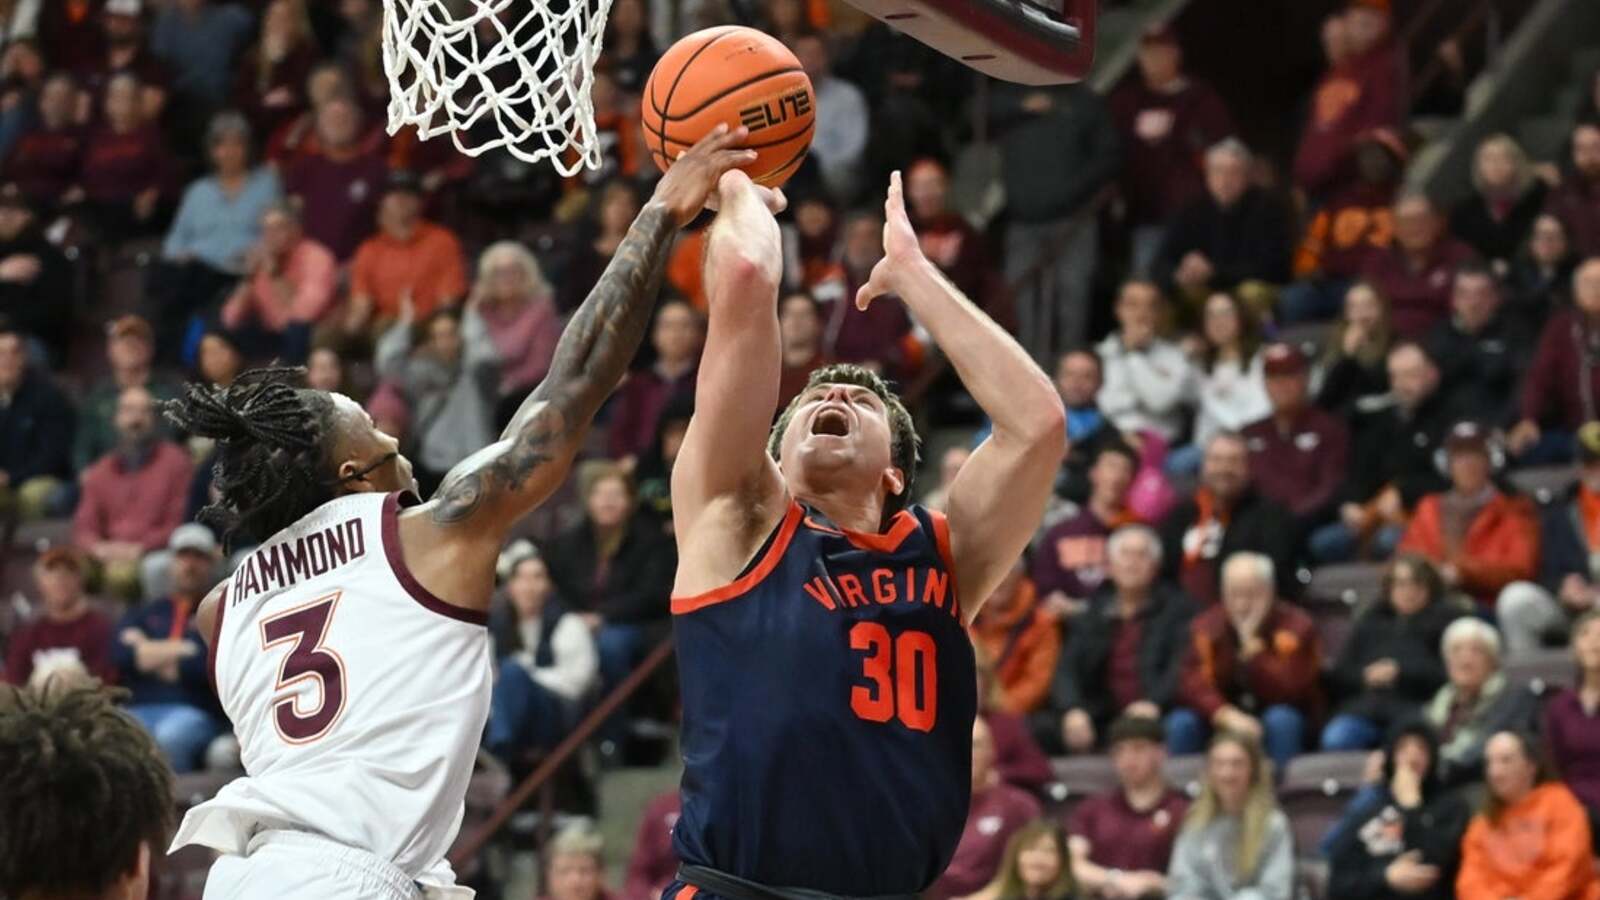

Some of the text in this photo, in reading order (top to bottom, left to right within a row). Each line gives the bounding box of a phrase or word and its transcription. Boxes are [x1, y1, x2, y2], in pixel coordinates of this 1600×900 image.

[740, 90, 811, 132] ELITE
[232, 518, 365, 607] HAMMOND
[260, 591, 346, 745] 3
[850, 621, 936, 733] 30
